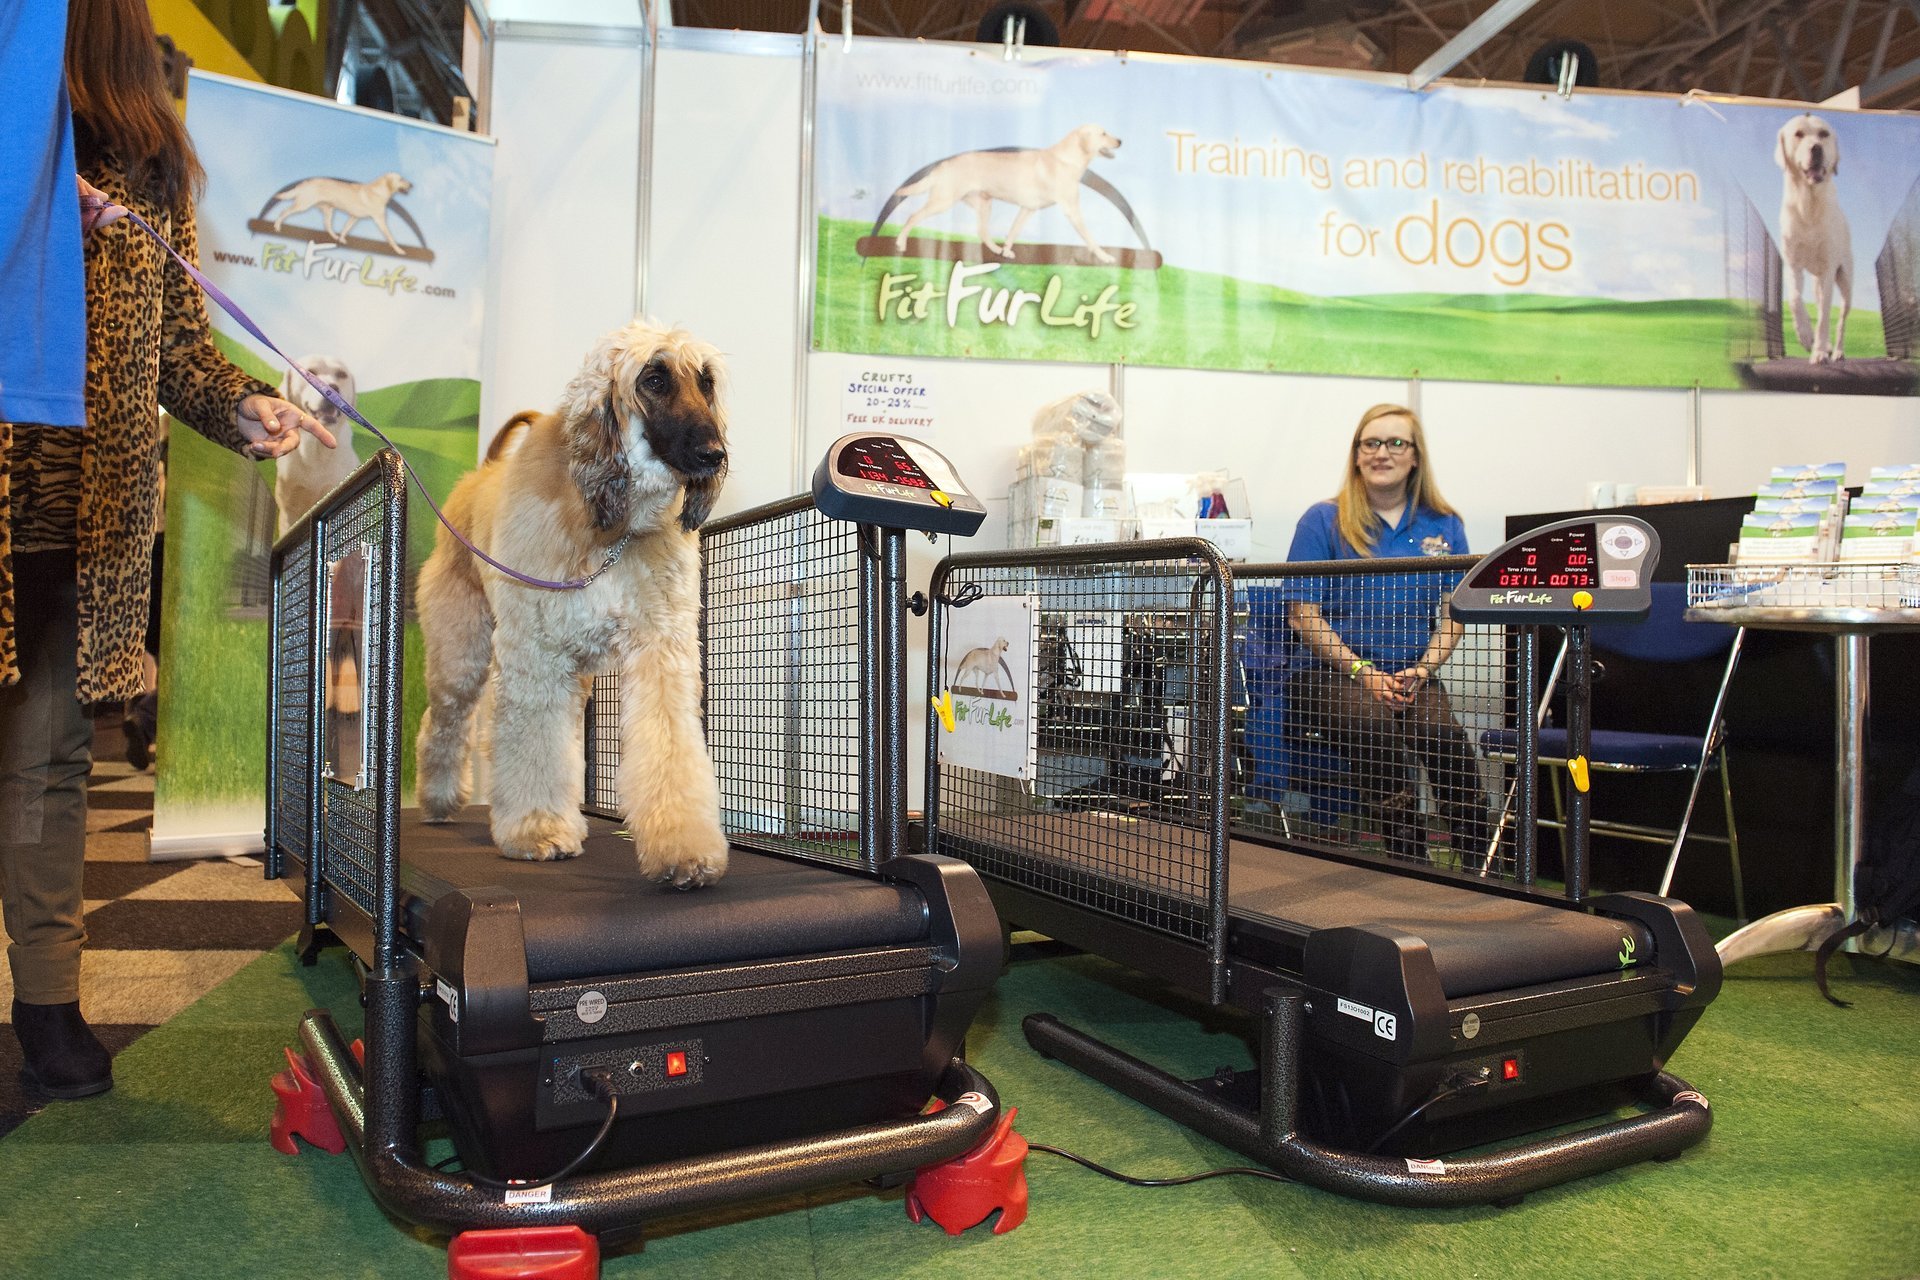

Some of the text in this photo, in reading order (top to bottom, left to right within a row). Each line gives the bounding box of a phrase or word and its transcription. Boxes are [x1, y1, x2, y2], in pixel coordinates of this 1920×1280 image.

[856, 71, 1037, 96] www.fitfurlife.com
[1166, 131, 1699, 201] Training and rehabilitation
[1319, 198, 1573, 286] for dogs
[861, 371, 913, 384] CRUFTS
[848, 383, 926, 396] SPECIAL OFFER
[889, 417, 934, 427] DELIVERY
[1527, 554, 1536, 565] 0
[1610, 574, 1631, 583] Stop
[1377, 1016, 1395, 1037] CE
[508, 1191, 547, 1199] DANGER
